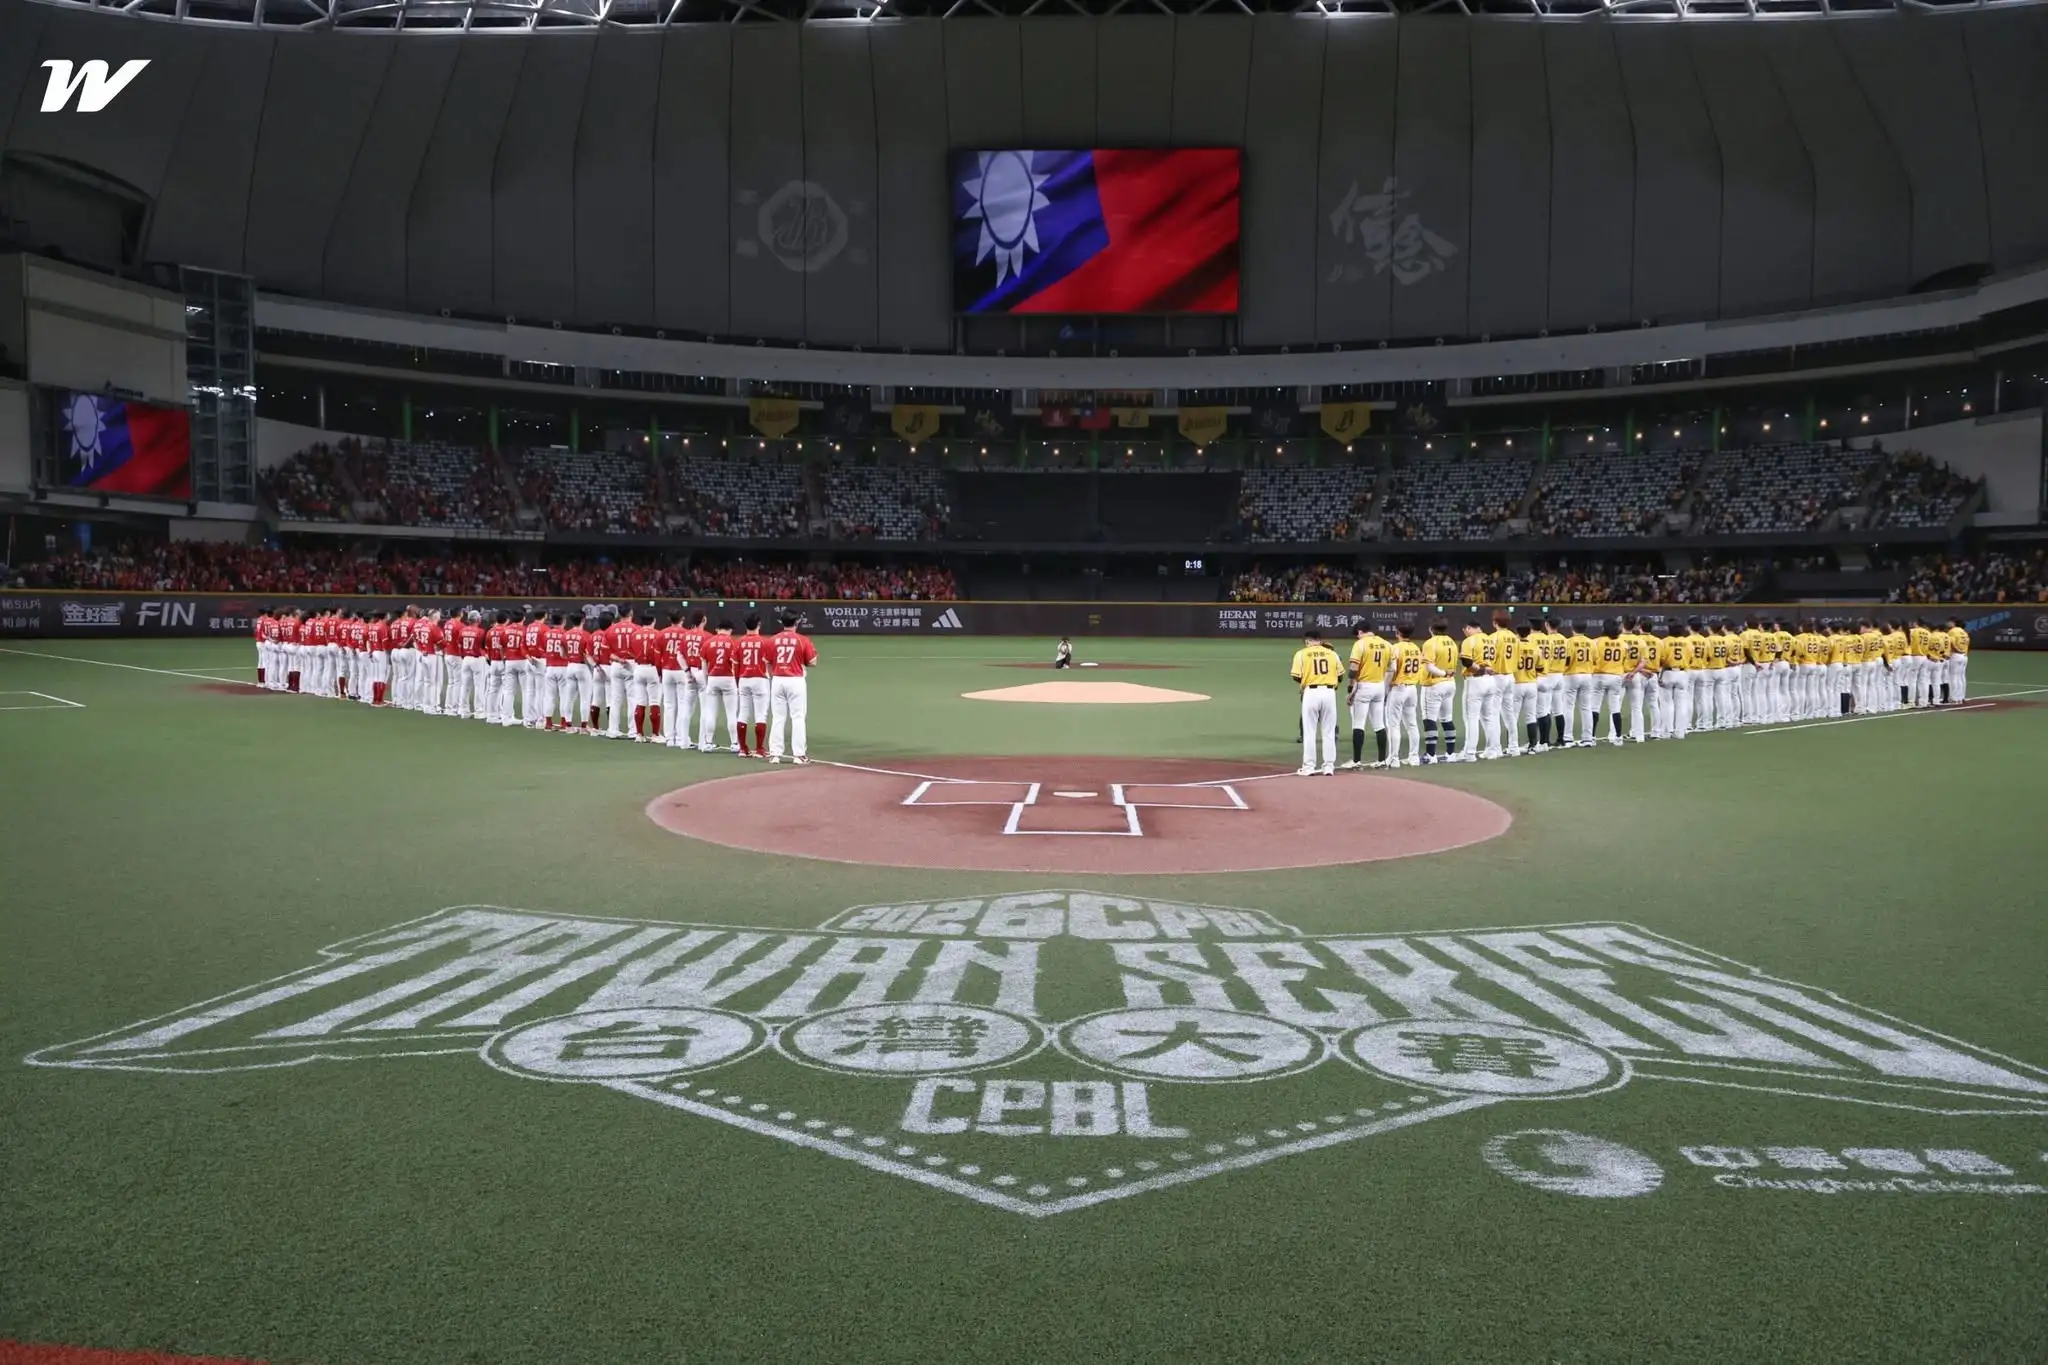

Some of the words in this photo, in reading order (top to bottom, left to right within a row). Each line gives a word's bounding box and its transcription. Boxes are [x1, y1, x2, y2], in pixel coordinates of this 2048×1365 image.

[1185, 560, 1202, 569] 0:18
[136, 602, 196, 626] FIN
[824, 608, 868, 616] WORLD
[1219, 610, 1257, 619] HERAN
[832, 618, 860, 627] GYM
[1265, 620, 1303, 628] TOSTEM
[507, 635, 520, 648] 31
[716, 649, 725, 664] 2
[743, 649, 759, 665] 21
[777, 646, 795, 663] 27
[1373, 651, 1382, 667] 4
[1483, 645, 1495, 660] 29
[1505, 645, 1513, 659] 9
[1577, 649, 1589, 662] 31
[1604, 648, 1621, 662] 80
[1648, 647, 1657, 660] 3
[1674, 648, 1683, 661] 5
[1313, 658, 1329, 675] 10
[1404, 658, 1419, 673] 28
[843, 891, 1067, 939] 2026
[1067, 893, 1282, 941] CPBL
[74, 908, 1045, 1053] TAIWAN
[1108, 926, 2048, 1094] SERIES
[555, 1011, 1561, 1081] 台灣大賽
[899, 1079, 1191, 1139] CPBL
